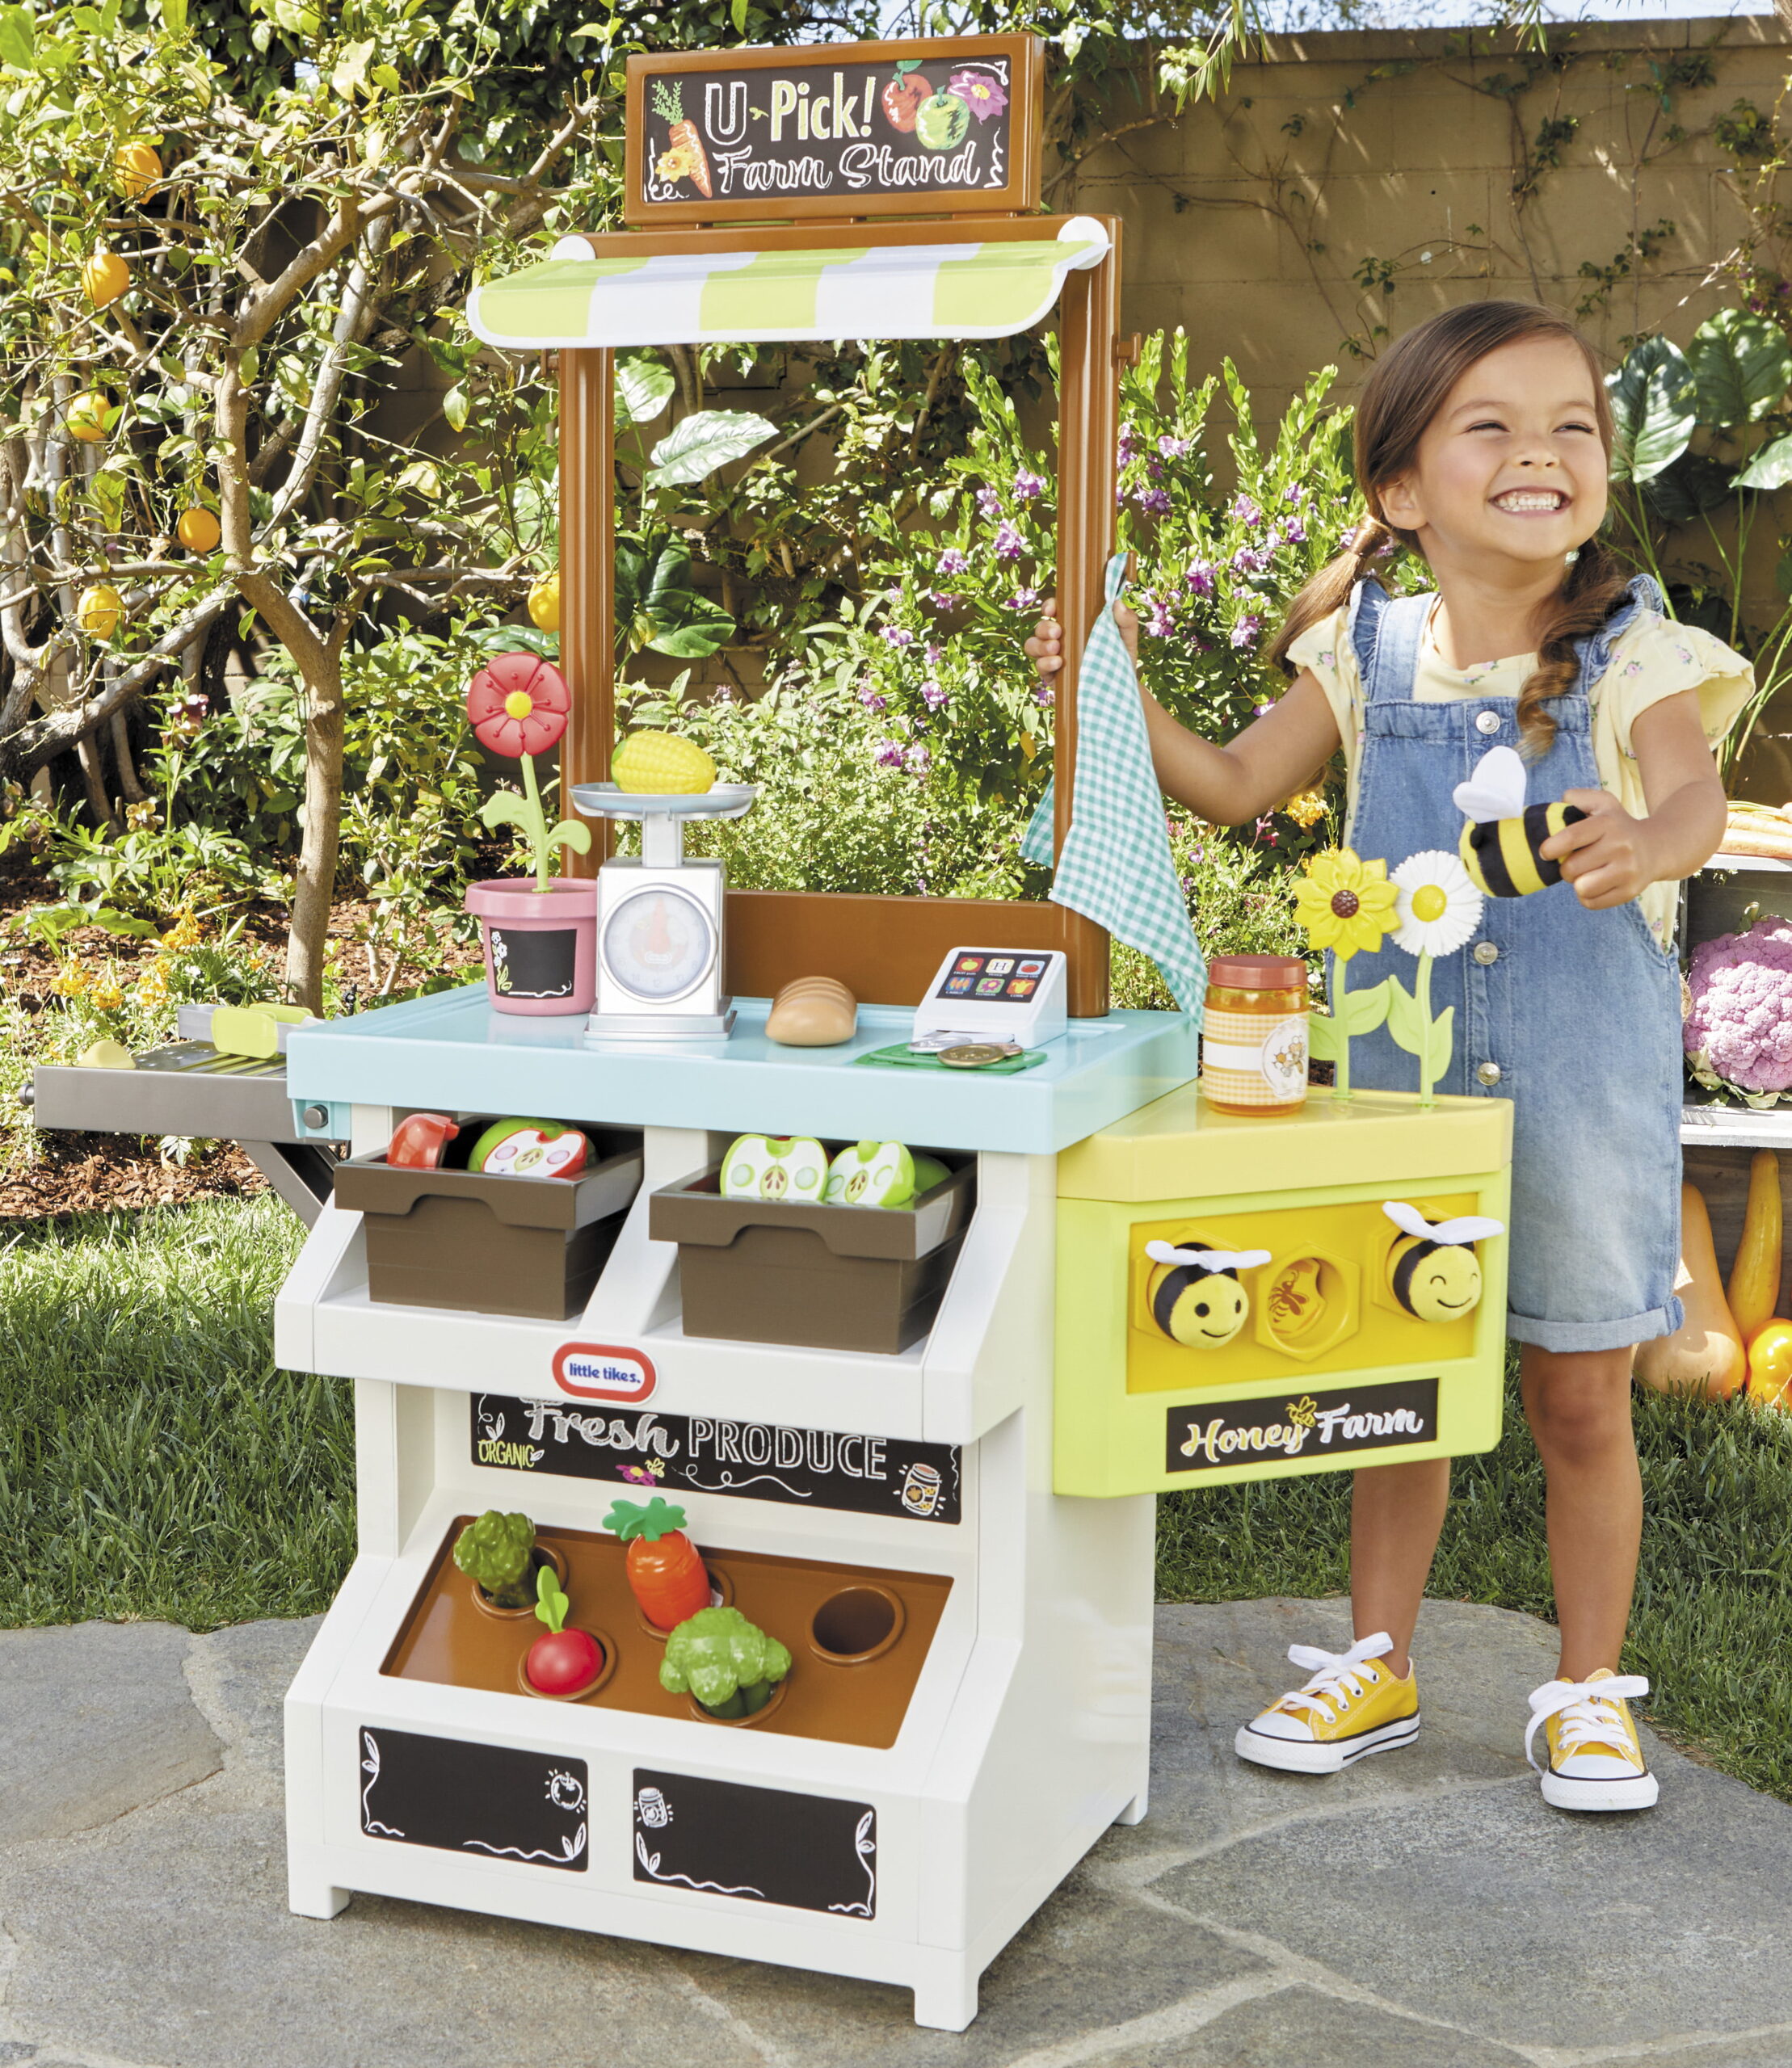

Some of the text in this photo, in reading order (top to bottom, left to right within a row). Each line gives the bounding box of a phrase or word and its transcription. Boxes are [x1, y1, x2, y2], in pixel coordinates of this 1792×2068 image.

[705, 72, 876, 145] U Pick!
[712, 140, 981, 193] Farm Stand
[569, 1363, 599, 1379] little
[477, 1440, 535, 1470] ORGANIC
[520, 1398, 887, 1481] Fresh PRODUCE
[1180, 1402, 1424, 1463] Honey Farm
